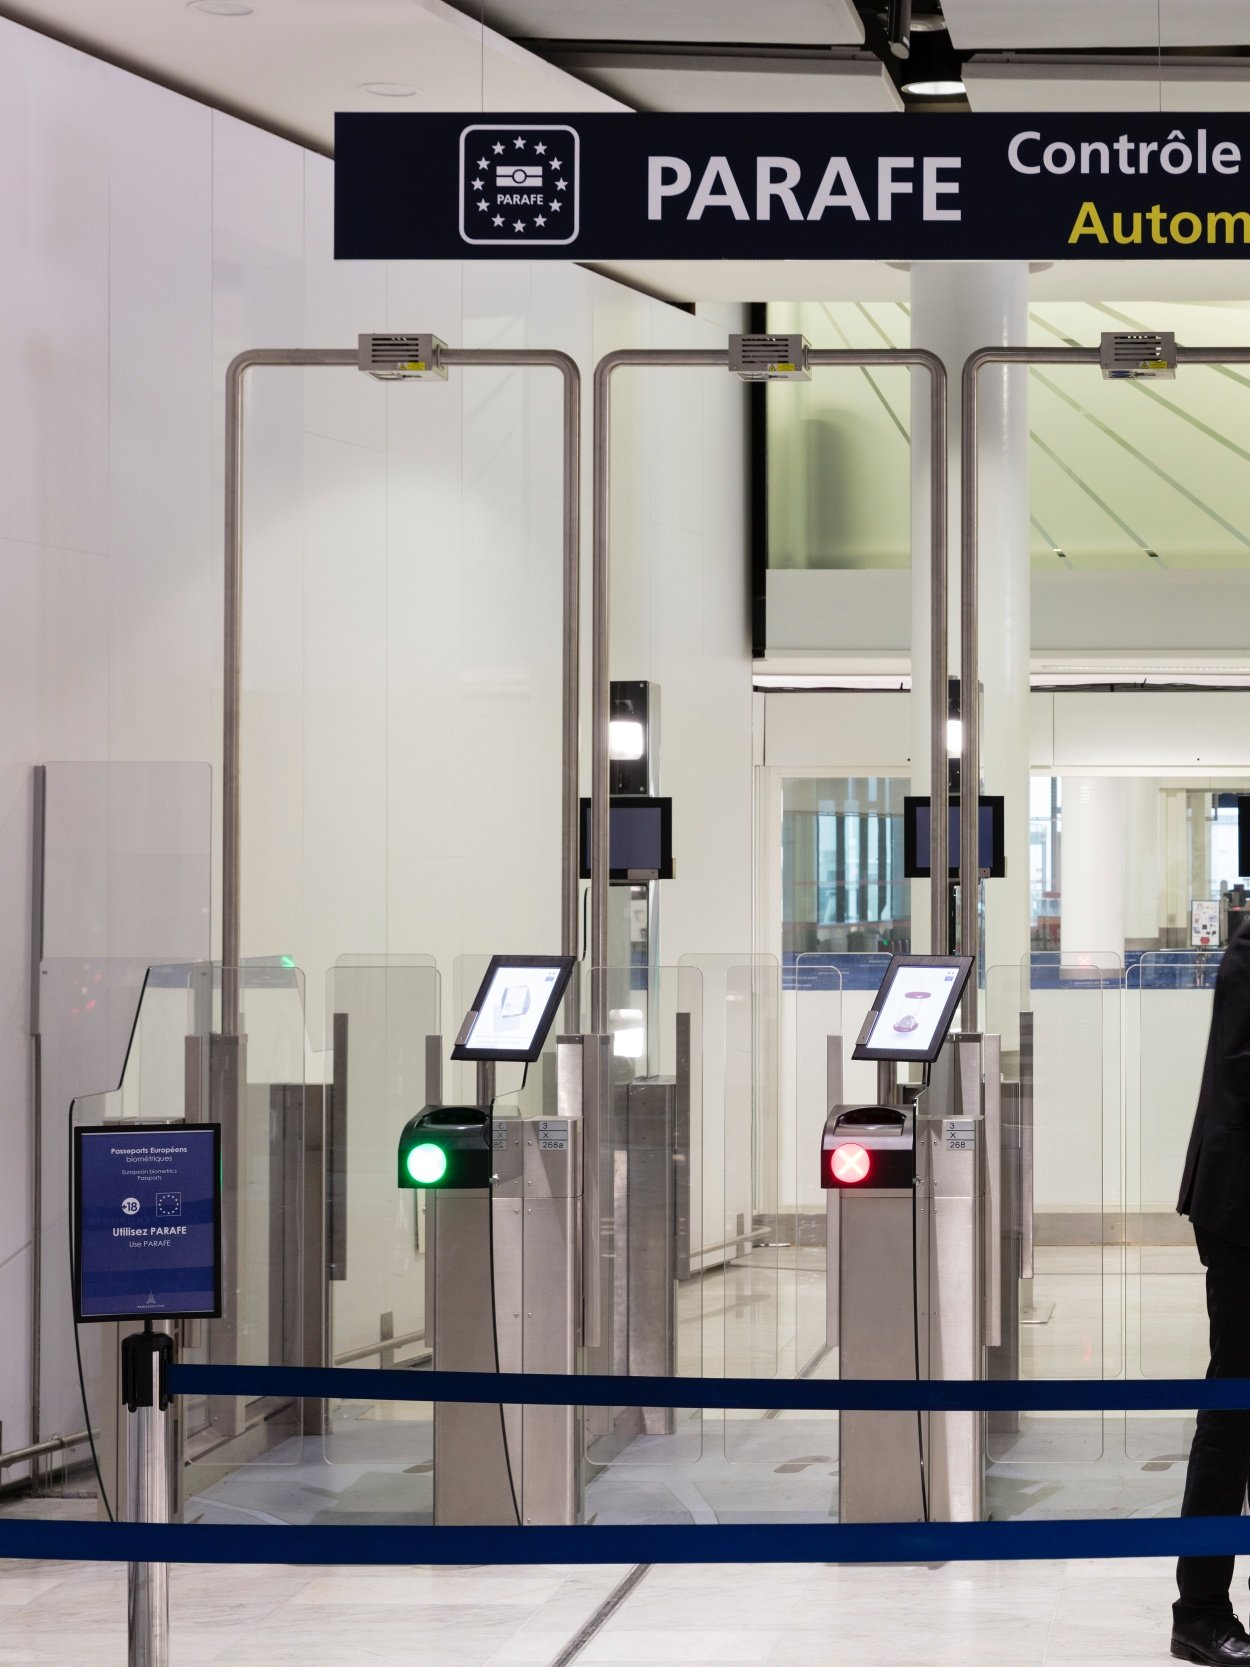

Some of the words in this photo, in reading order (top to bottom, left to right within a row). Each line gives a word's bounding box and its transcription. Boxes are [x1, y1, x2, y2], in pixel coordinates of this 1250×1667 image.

[1007, 128, 1242, 175] Contrôle
[647, 155, 962, 221] PARAFE
[497, 193, 544, 205] PARAFE
[949, 1122, 955, 1130] 3
[949, 1131, 957, 1139] X
[110, 1147, 149, 1155] Passeports
[150, 1145, 188, 1154] Européens
[949, 1141, 966, 1149] 268
[122, 1201, 138, 1212] +18
[112, 1227, 148, 1237] Utilisez
[150, 1226, 187, 1236] PARAFE
